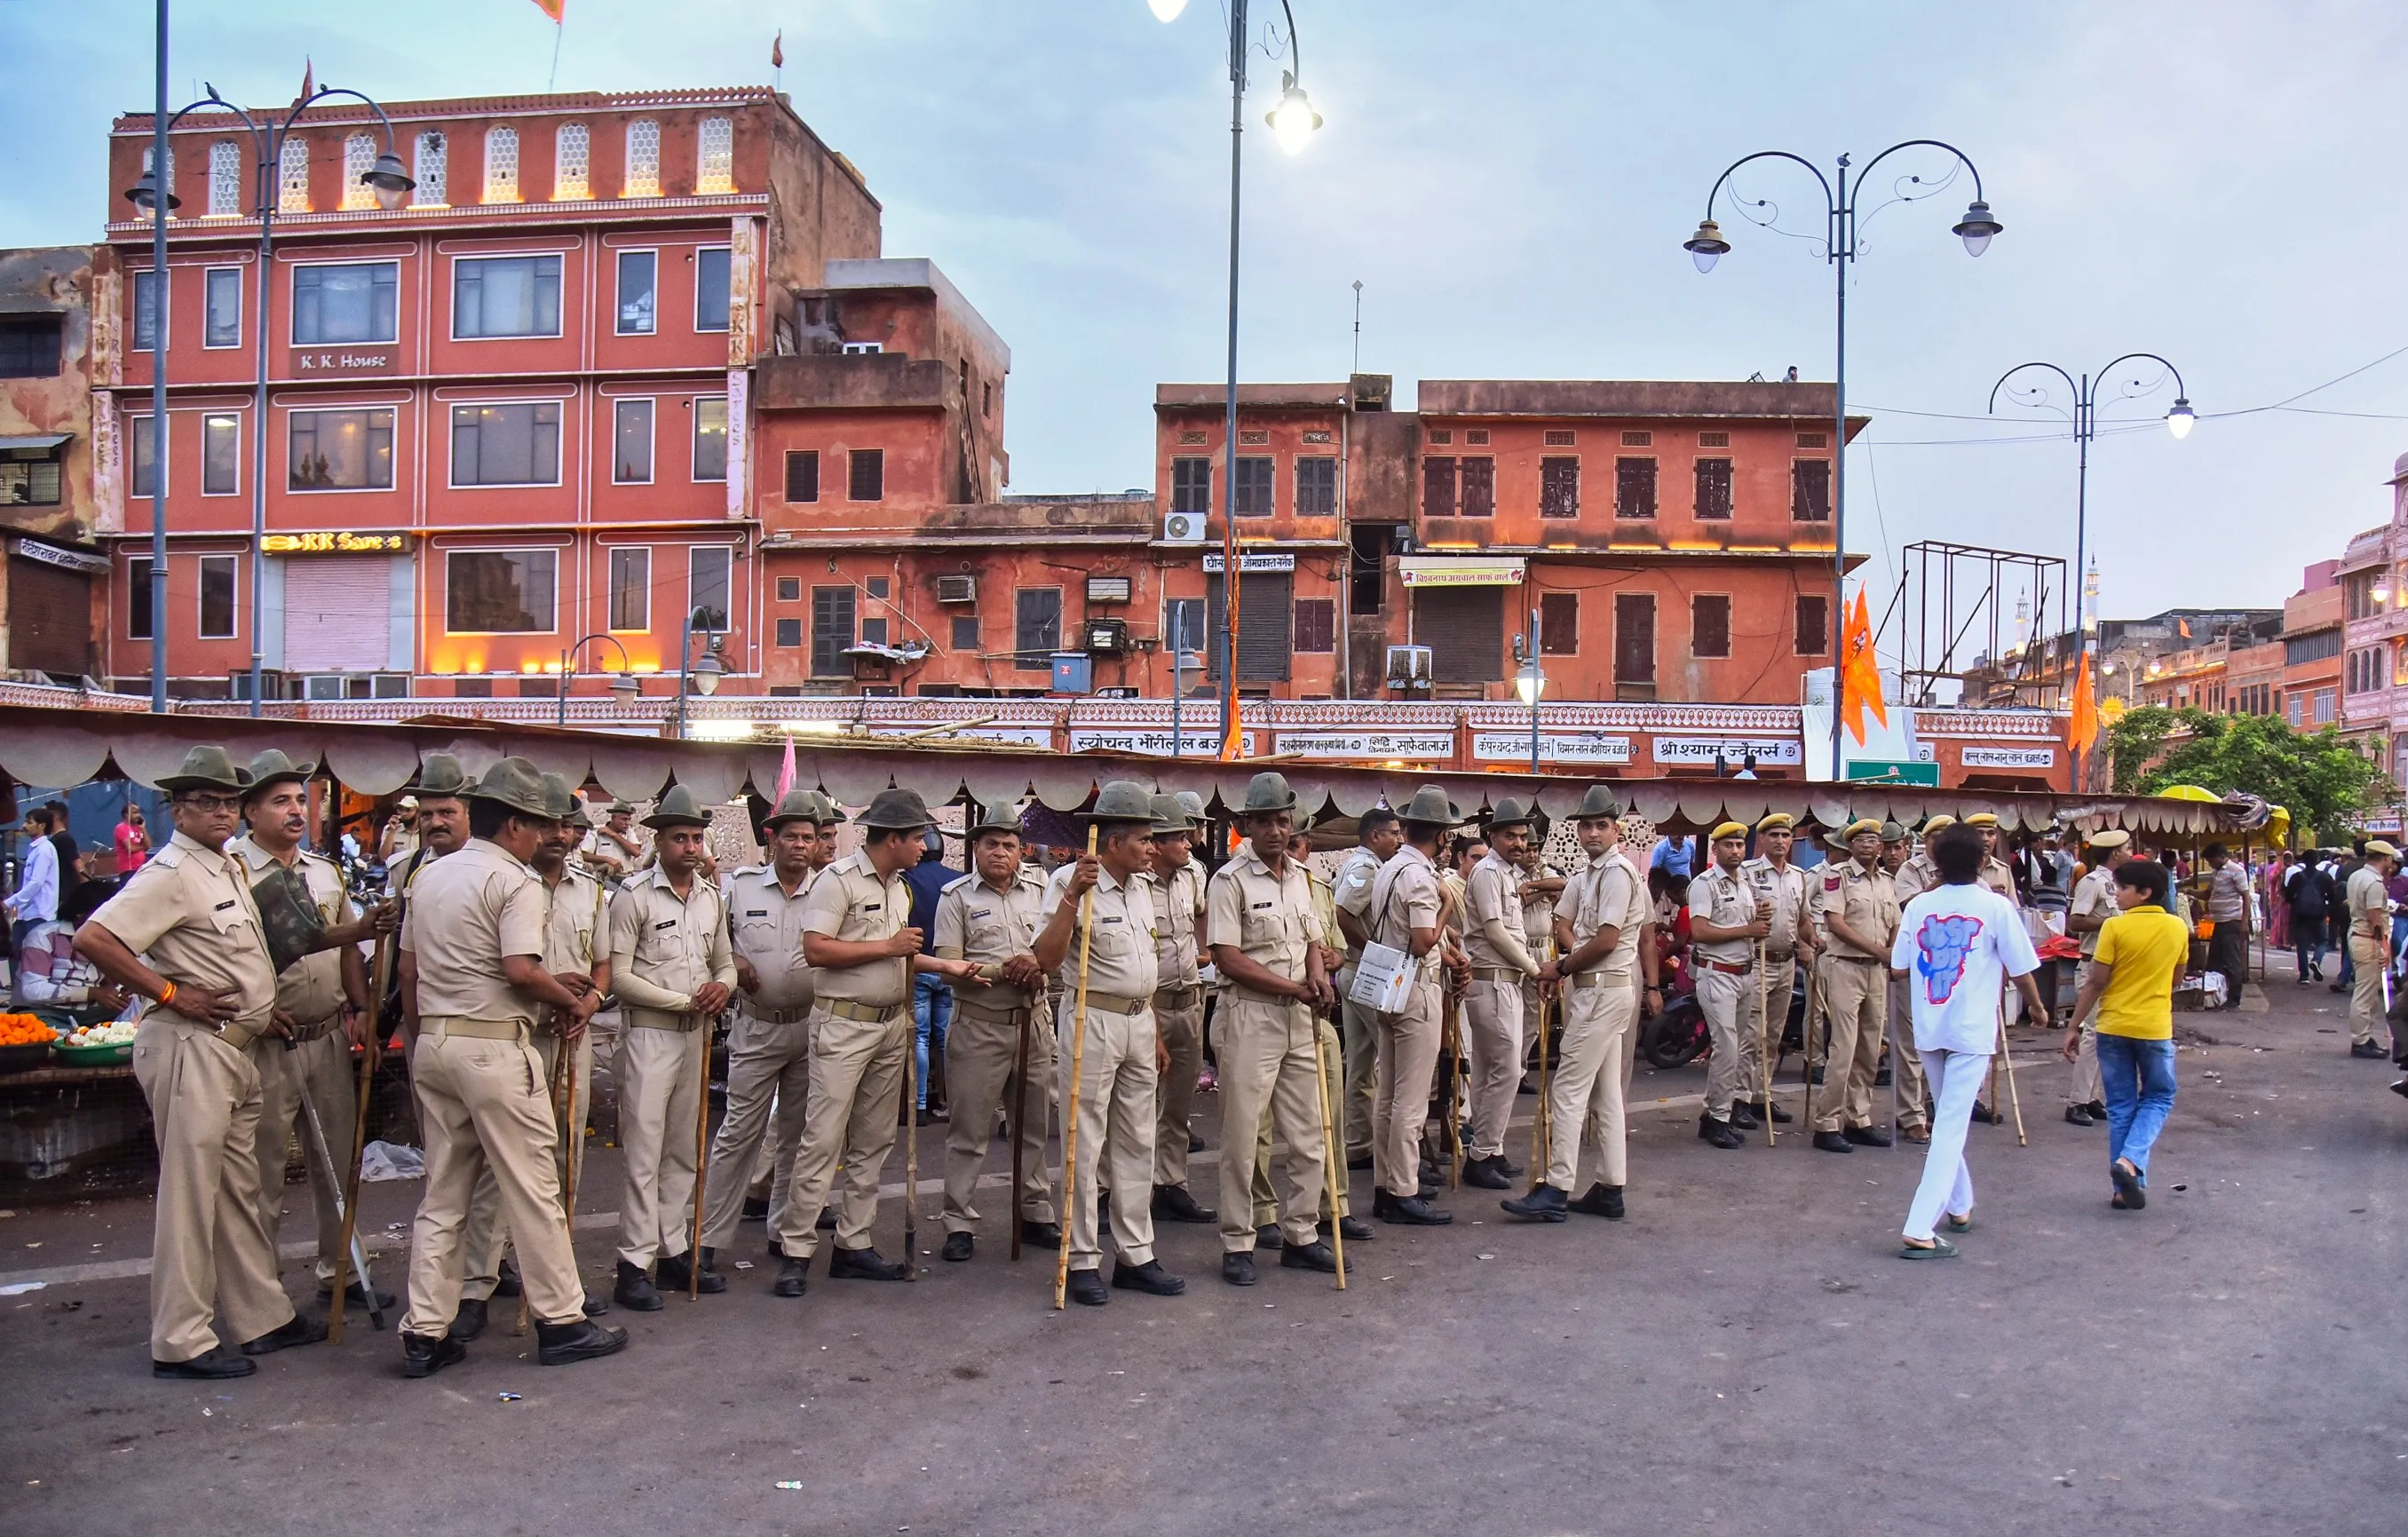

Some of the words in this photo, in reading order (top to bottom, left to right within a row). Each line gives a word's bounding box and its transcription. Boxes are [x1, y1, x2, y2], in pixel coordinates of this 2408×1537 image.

[300, 354, 317, 369] K.
[321, 354, 337, 369] K.
[340, 353, 387, 368] House
[337, 531, 402, 551] Sarees
[1660, 741, 1678, 756] श्री
[1680, 744, 1724, 757] श्याम
[1726, 741, 1780, 758] ज्वैलर्स
